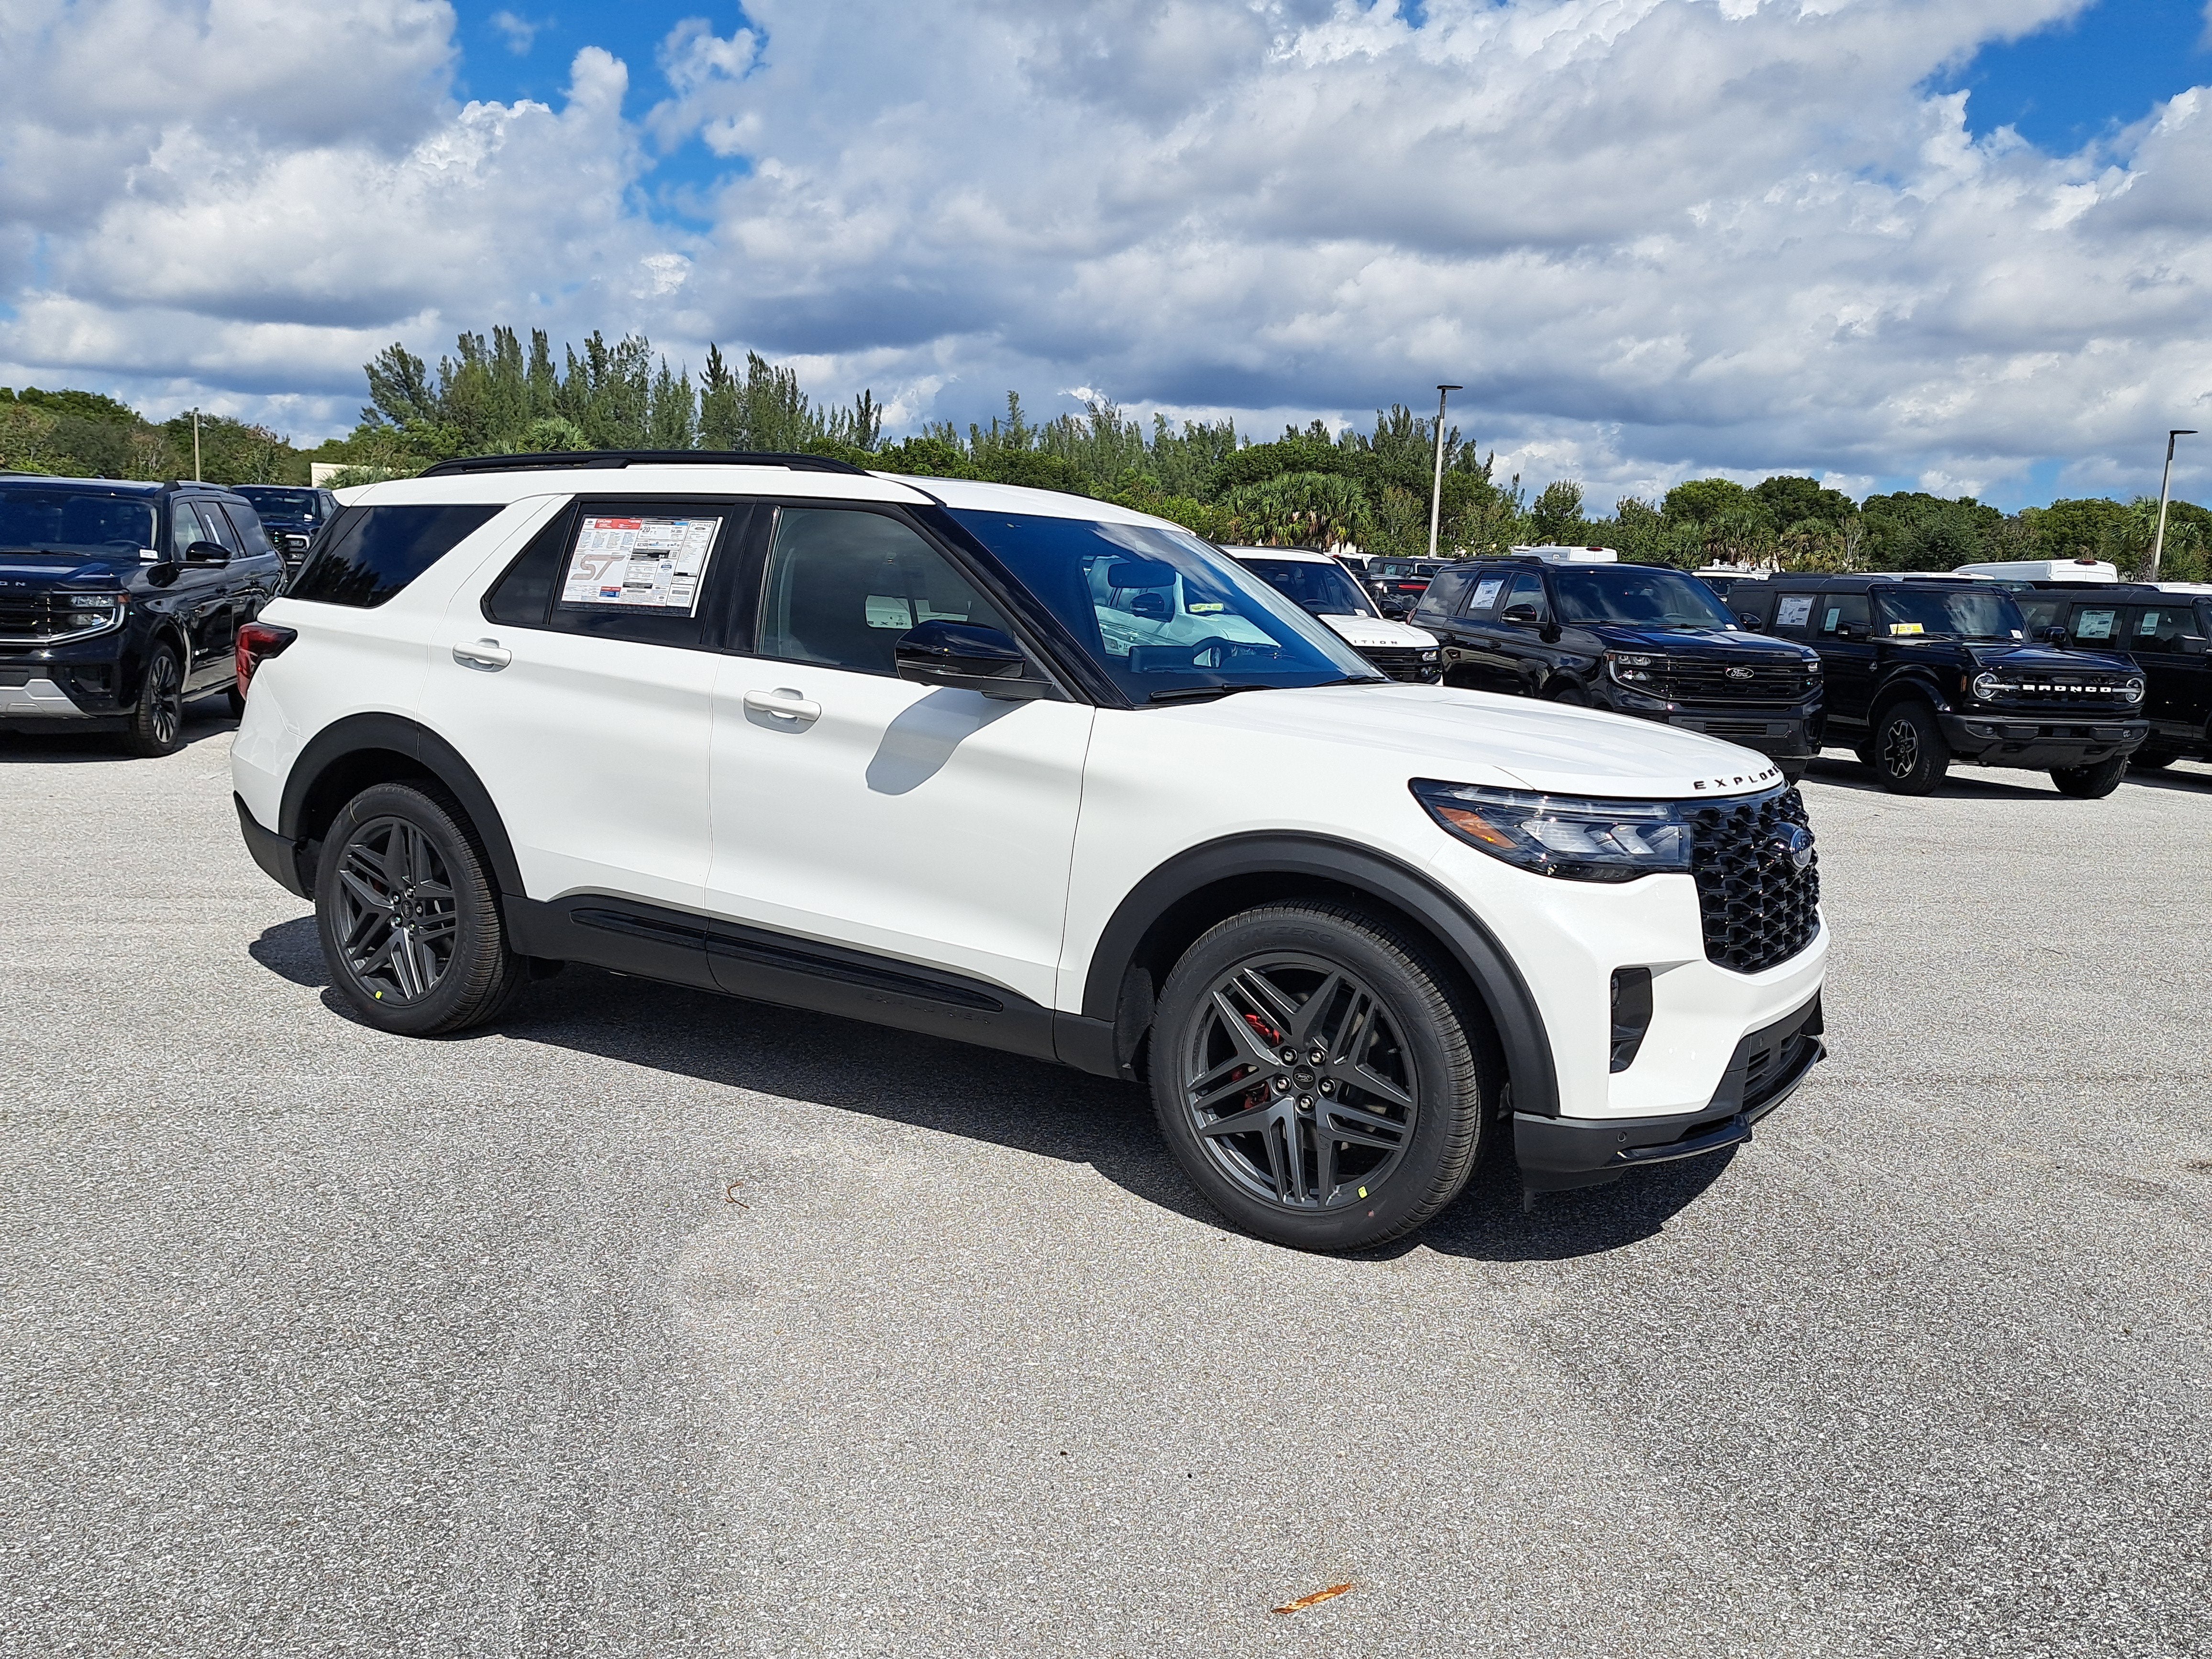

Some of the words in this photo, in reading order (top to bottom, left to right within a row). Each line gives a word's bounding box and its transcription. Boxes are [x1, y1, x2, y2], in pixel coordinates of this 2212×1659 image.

[571, 554, 625, 581] ST
[2023, 685, 2112, 693] BRONCO
[1693, 762, 1780, 790] EXPLORE
